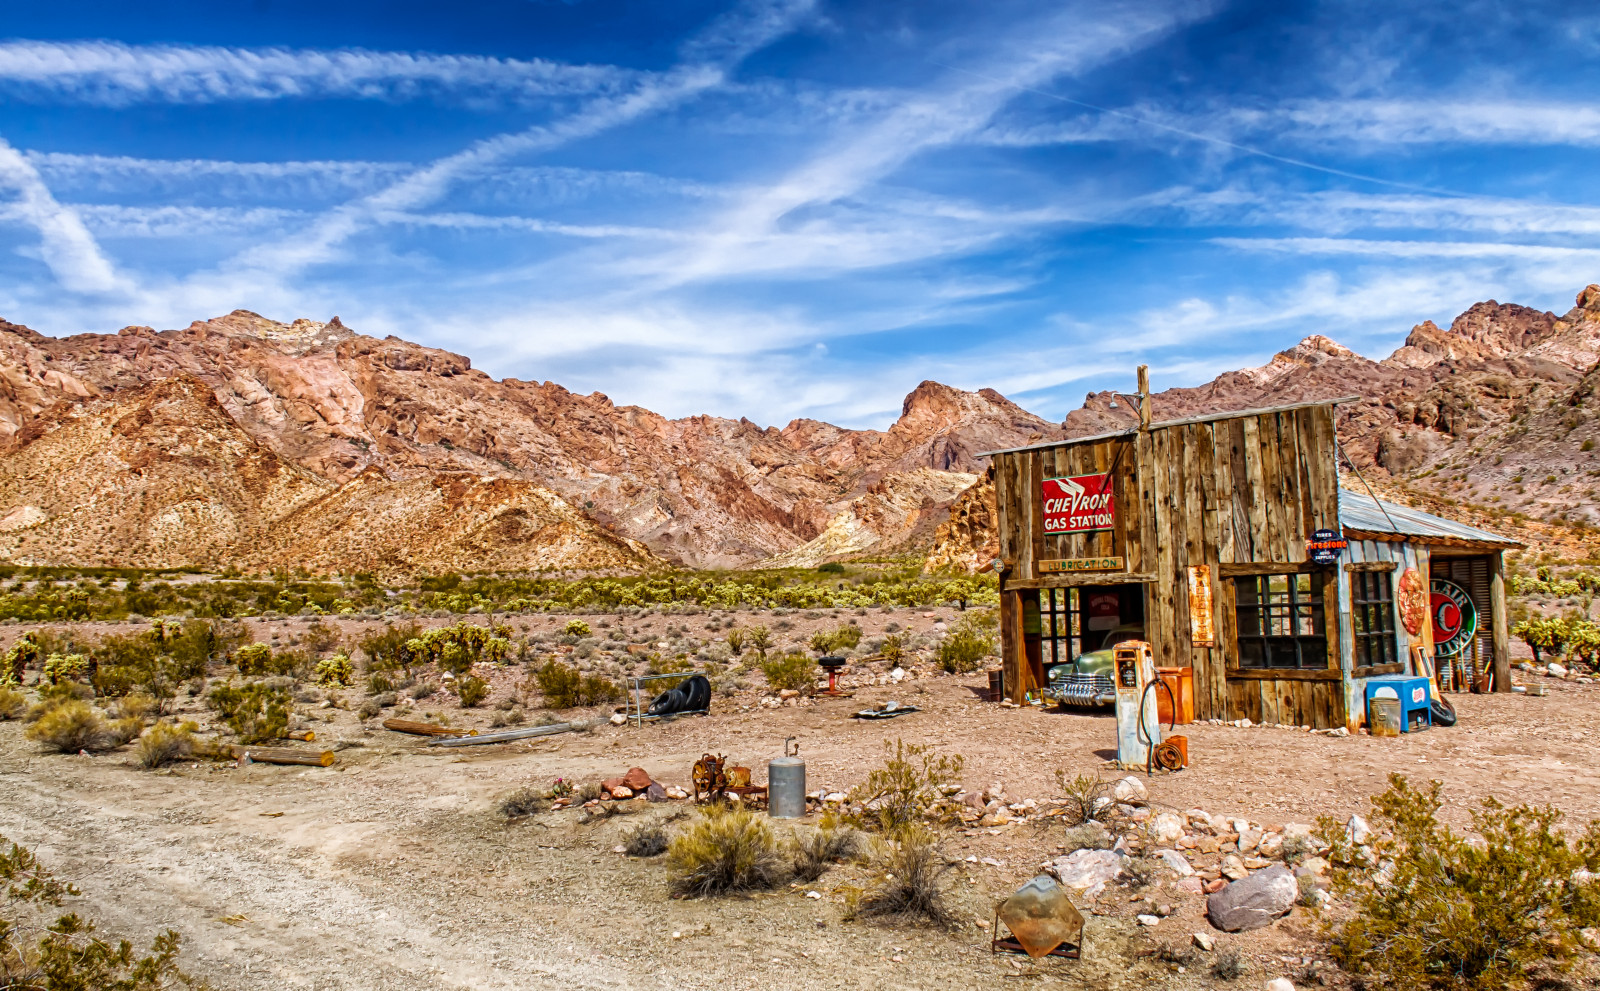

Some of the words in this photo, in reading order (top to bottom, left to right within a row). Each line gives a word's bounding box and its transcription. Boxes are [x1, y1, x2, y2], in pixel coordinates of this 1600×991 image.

[1045, 485, 1110, 515] CHEVRON
[1044, 517, 1067, 530] GAS
[1069, 513, 1113, 528] STATION
[1305, 539, 1348, 550] Firestone
[1048, 559, 1117, 571] LUBRICATION
[1431, 581, 1468, 607] LAIR
[1433, 628, 1473, 656] LINE
